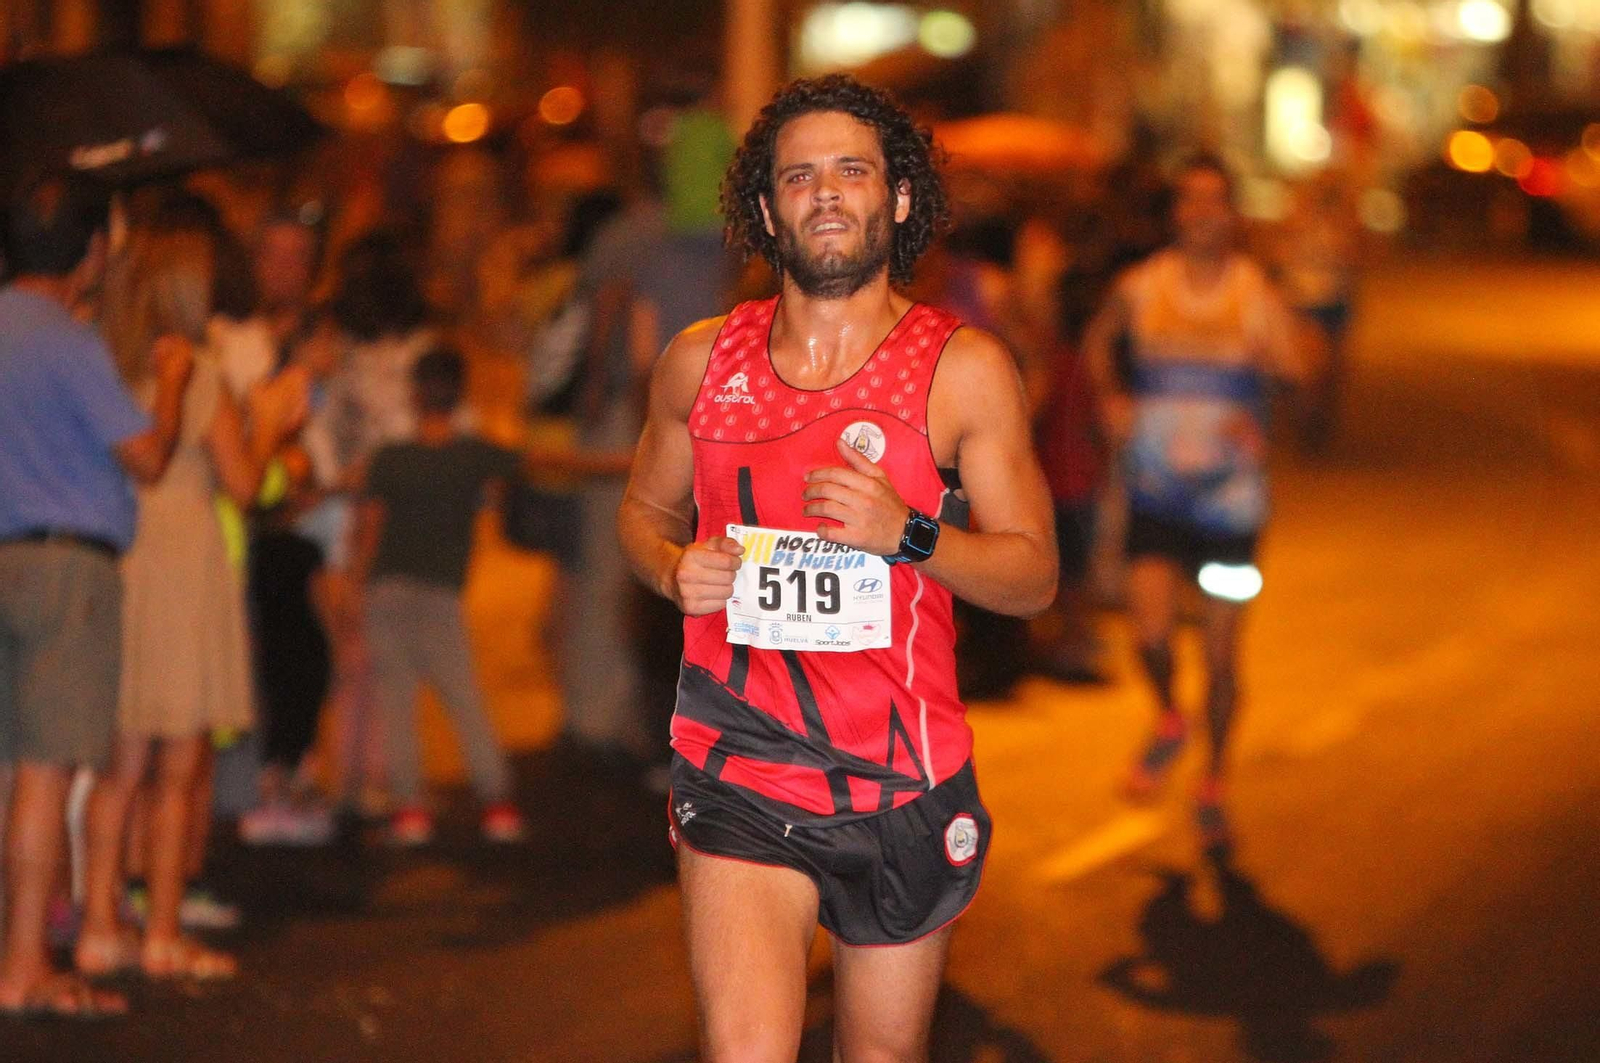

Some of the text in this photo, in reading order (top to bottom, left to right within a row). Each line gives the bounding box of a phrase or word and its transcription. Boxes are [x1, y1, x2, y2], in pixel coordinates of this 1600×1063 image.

[771, 550, 865, 570] DE HUELVA
[758, 566, 841, 615] 519
[786, 613, 812, 622] RUBEN
